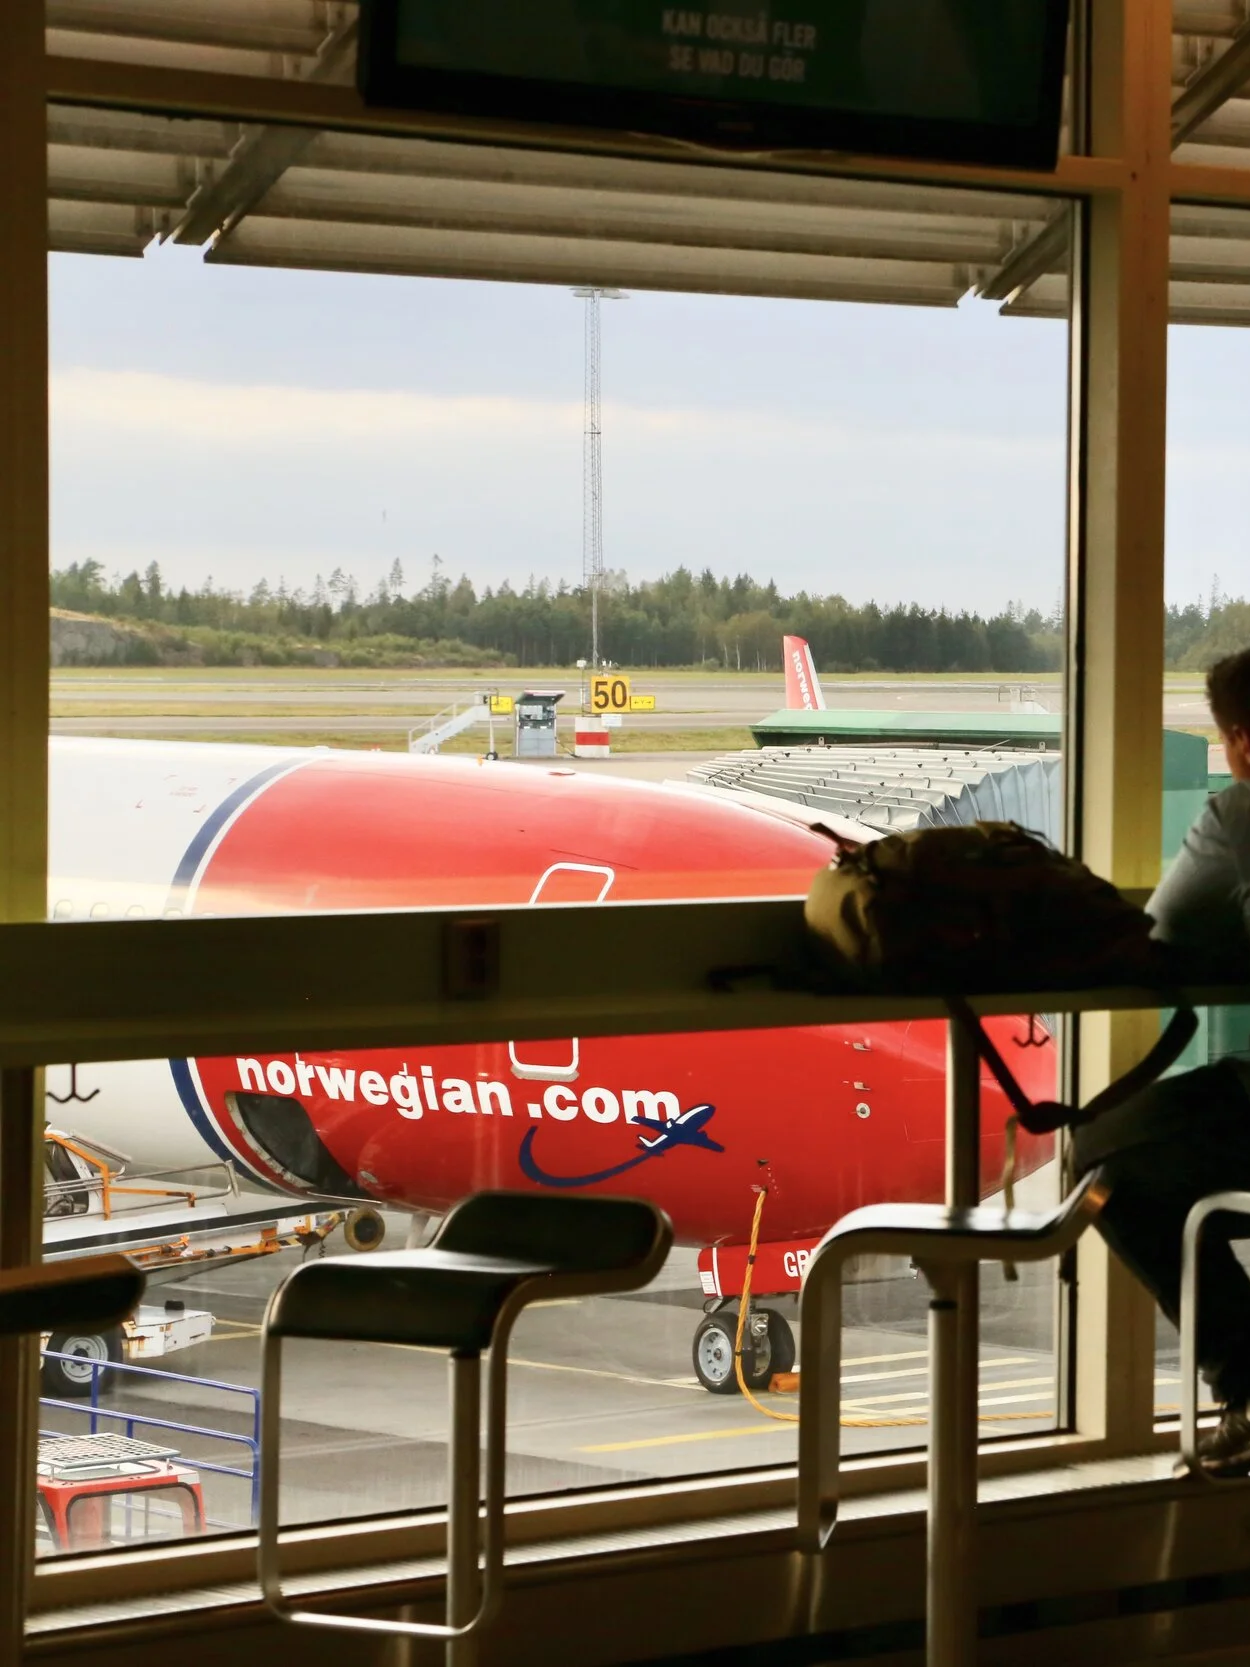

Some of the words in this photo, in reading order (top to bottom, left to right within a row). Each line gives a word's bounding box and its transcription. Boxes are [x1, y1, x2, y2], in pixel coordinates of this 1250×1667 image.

[662, 8, 702, 37] KAN
[706, 9, 768, 44] OCKSÅ
[772, 20, 817, 51] FLER
[669, 44, 693, 72] SE
[698, 47, 735, 76] VAD
[738, 52, 764, 78] DU
[768, 49, 806, 83] GÖR
[594, 680, 627, 709] 50
[236, 1056, 514, 1120] norwegian
[526, 1084, 681, 1125] .com
